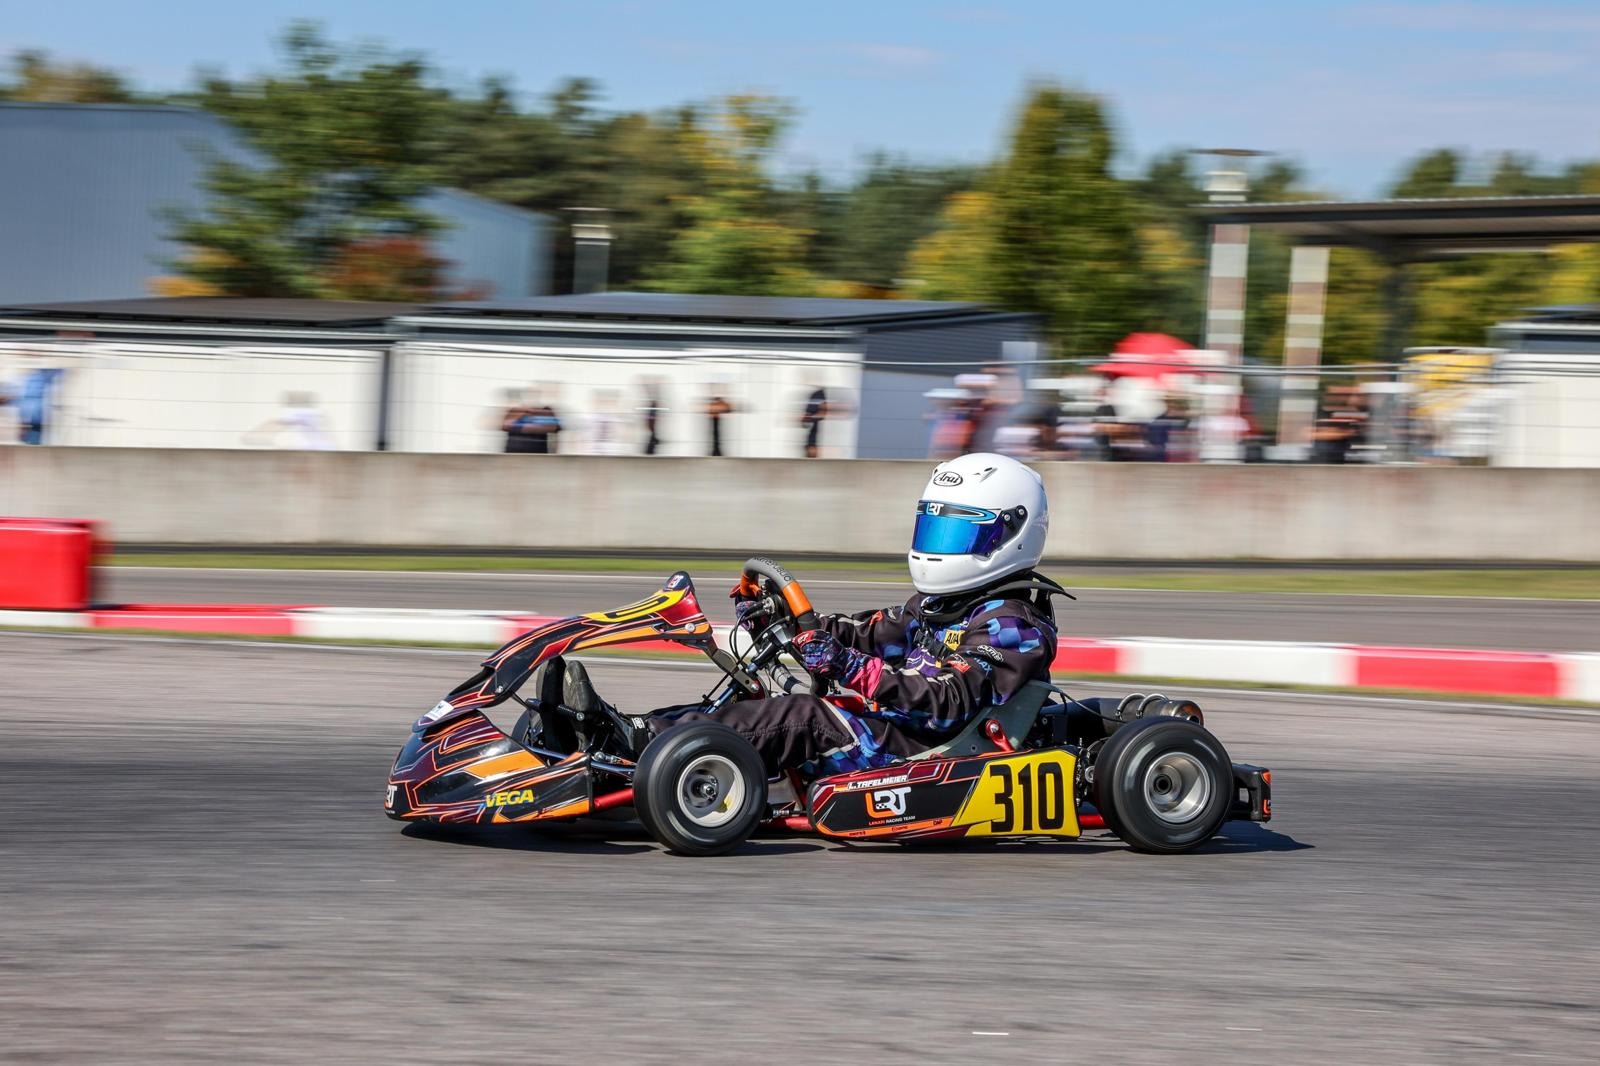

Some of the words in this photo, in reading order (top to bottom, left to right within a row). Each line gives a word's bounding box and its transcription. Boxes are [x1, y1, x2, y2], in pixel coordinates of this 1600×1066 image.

[936, 472, 960, 484] Arai
[926, 502, 945, 516] LRT
[485, 789, 535, 808] VEGA
[865, 786, 912, 819] LRT
[990, 761, 1065, 833] 310
[885, 816, 903, 825] RACING
